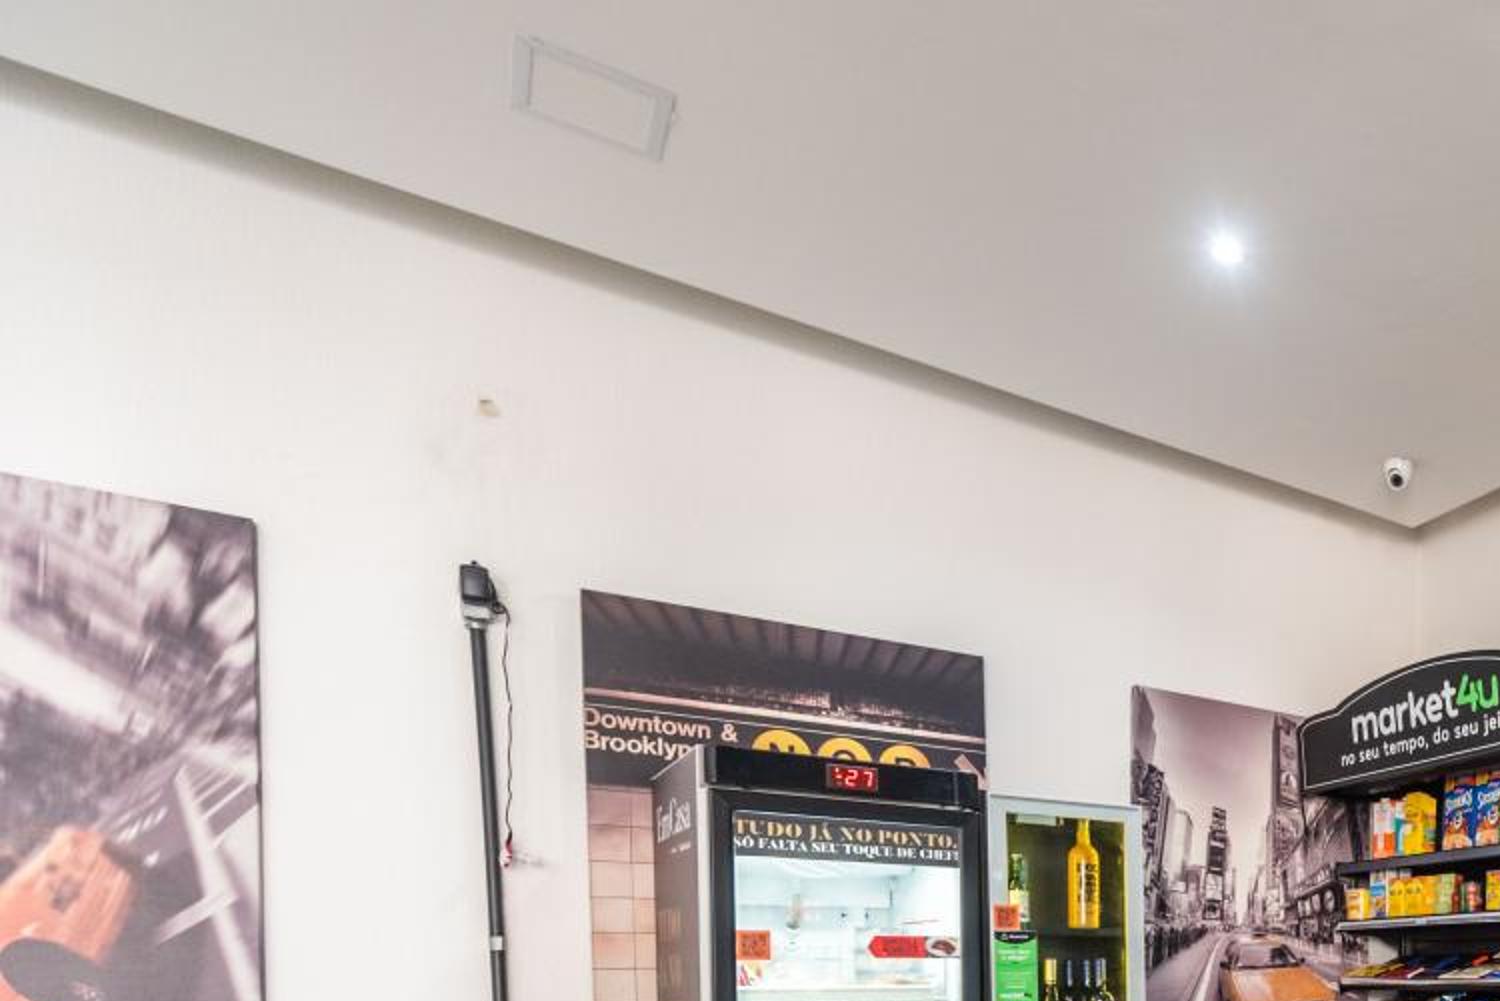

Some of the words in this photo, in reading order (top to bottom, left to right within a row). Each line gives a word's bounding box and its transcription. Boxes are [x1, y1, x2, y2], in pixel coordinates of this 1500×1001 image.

[584, 708, 712, 740] Downtown
[720, 723, 739, 743] &
[1351, 672, 1500, 744] market4u
[1341, 754, 1357, 767] no
[1359, 746, 1380, 763] seu
[1383, 734, 1429, 756] tempo,
[1433, 726, 1449, 744] do
[1453, 719, 1480, 739] seu
[734, 834, 754, 850] SÓ
[758, 837, 807, 853] FALTA
[811, 842, 839, 853] SEU
[843, 844, 893, 860] TOQUE
[896, 847, 917, 859] DE
[736, 817, 802, 838] TUDO
[810, 822, 833, 842] JÁ
[840, 826, 874, 844] NO
[878, 830, 958, 850] PONTO.
